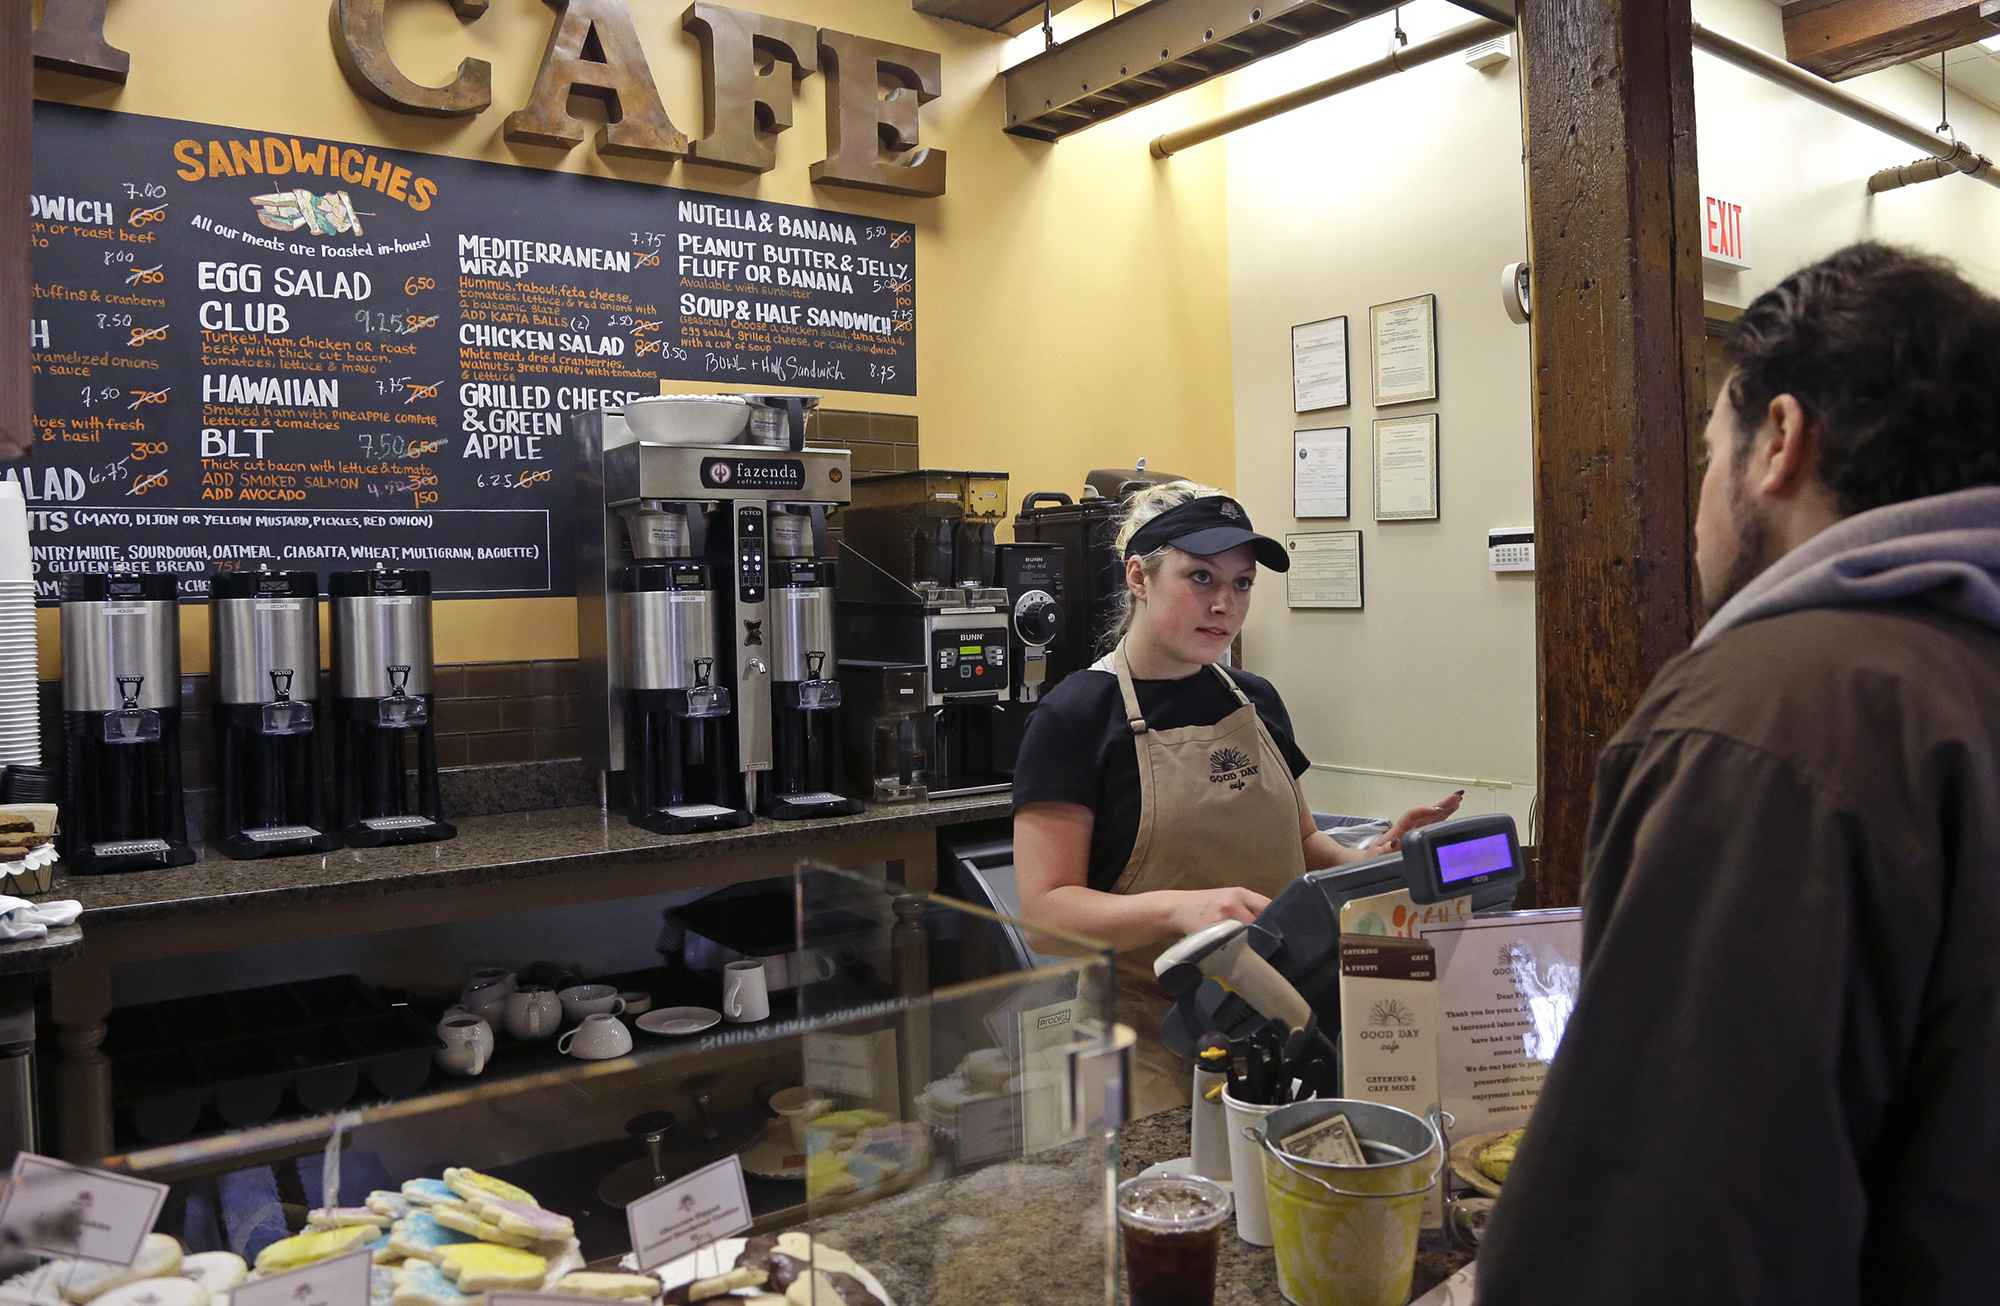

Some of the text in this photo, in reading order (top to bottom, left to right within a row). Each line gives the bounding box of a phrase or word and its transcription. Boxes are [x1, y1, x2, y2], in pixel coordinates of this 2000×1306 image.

[328, 0, 947, 197] CAFE
[173, 137, 438, 212] SANDWICHES
[678, 201, 857, 246] NUTELLA & BANANA
[1706, 196, 1742, 259] EXIT
[73, 226, 156, 243] roast beef
[191, 214, 432, 258] All our meats are roasted in-house!
[457, 233, 631, 273] MEDITERRANEAN
[678, 233, 909, 280] PEANUT BUTTER JELLY,
[459, 256, 529, 279] WRAP
[679, 255, 854, 294] FLUFF OR BANANA
[197, 261, 436, 301] EGG SALAD 650
[459, 275, 633, 304] Hummus, cheese,
[679, 277, 813, 300] Available with sunbutter
[105, 294, 165, 307] cranberry
[458, 289, 658, 316] tomatoes, red onions with
[472, 299, 561, 316] balsamic glaze
[199, 300, 290, 334] CLUB
[460, 309, 569, 328] ADD KAFTA BALLS
[755, 303, 801, 325] HALF
[807, 307, 891, 335] SANDWICH
[679, 315, 875, 342] (seasonal) chicken tuna
[200, 330, 418, 355] Turkey, ham, roast
[459, 323, 625, 356] CHICKEN SALAD
[681, 338, 703, 348] with
[738, 330, 811, 347] grilled cheese,
[202, 342, 392, 364] beef with thick cut bacon,
[459, 347, 625, 370] White meat, dried cranberries,
[50, 365, 91, 376] sauce
[111, 357, 159, 370] onions
[201, 355, 377, 375] tomatoes, lettuce mayo
[460, 360, 657, 379] walnuts, green with tomatoes
[473, 371, 516, 382] lettuce
[202, 374, 339, 408] HAWAIIAN
[459, 382, 640, 410] GRILLED CHEESE
[202, 404, 328, 419] Smoked ham with
[71, 416, 145, 430] with fresh
[273, 418, 340, 431] tomatoes
[461, 408, 562, 436] & GREEN
[42, 428, 100, 442] & basil
[201, 428, 274, 459] BLT
[130, 442, 168, 460] 300
[462, 432, 543, 460] APPLE
[200, 459, 432, 476] Thick cut bacon with lettuce tomato
[737, 463, 797, 478] fazenda
[202, 472, 359, 490] ADD SMOKED SALMON
[202, 488, 439, 508] ADD AVOCADO 150
[73, 510, 433, 529] (MAYO, DIJON OR YELLOW RED ONION)
[77, 544, 540, 561] WHITE, SOURDOUGH, OATMEAL, CIABATTA, WHEAT, MULTIGRAIN, BAGUETTE)
[156, 561, 205, 572] BREAD
[1210, 765, 1258, 783] GOOD DAY
[1471, 1009, 1483, 1017] you
[1360, 1030, 1420, 1039] GOOD DAY
[1461, 1023, 1495, 1031] increased
[1474, 1075, 1534, 1087] preservative-free
[1472, 1092, 1510, 1101] enjoyment
